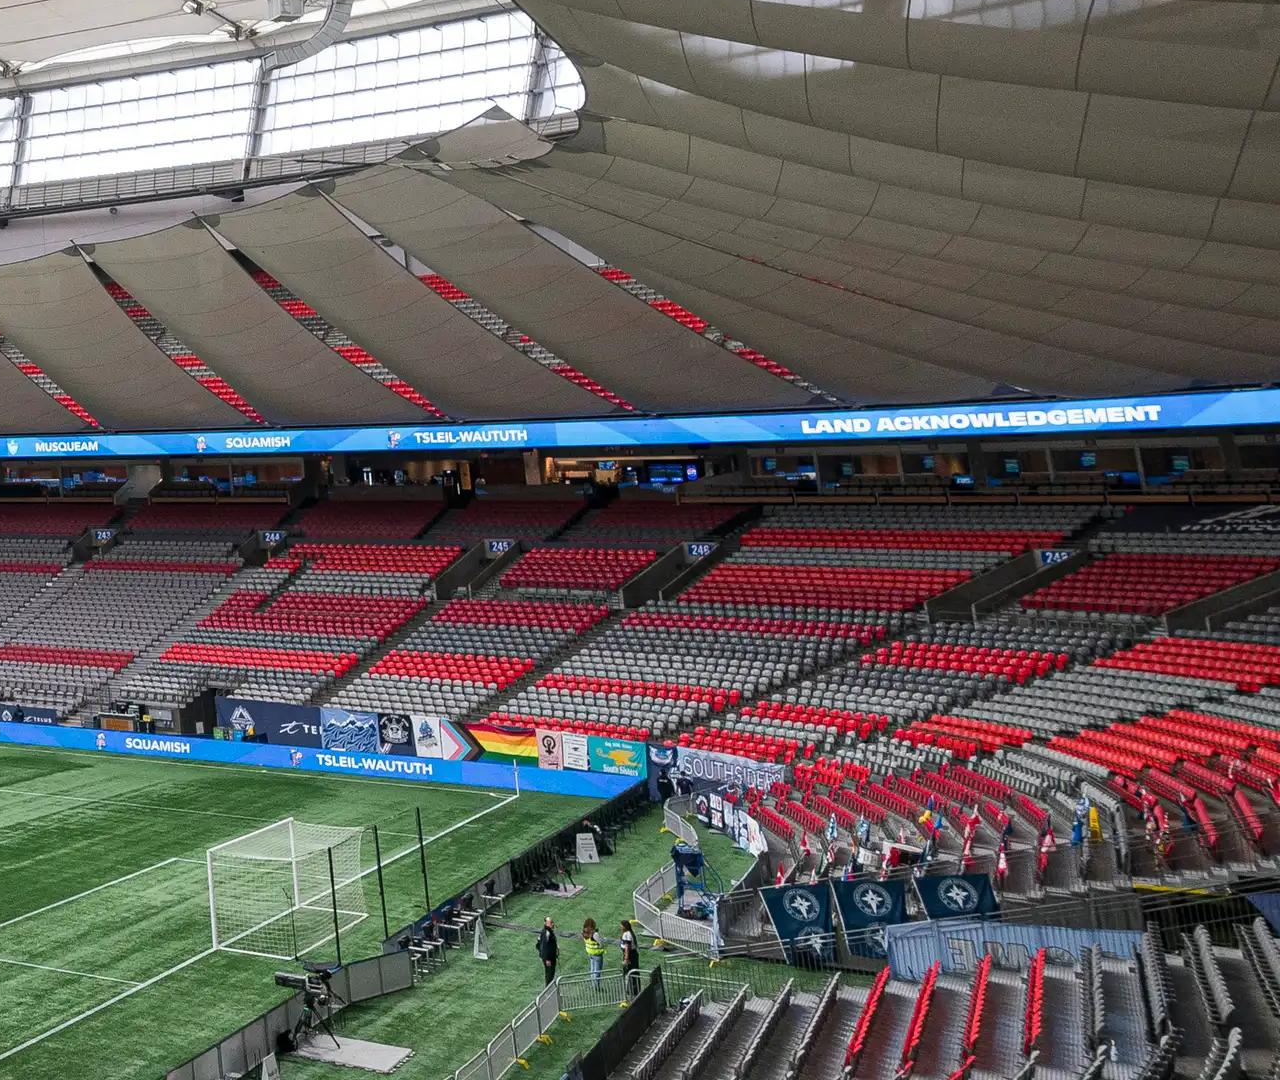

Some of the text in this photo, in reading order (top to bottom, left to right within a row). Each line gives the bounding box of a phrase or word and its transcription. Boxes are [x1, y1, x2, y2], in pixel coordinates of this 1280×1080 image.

[801, 405, 1161, 434] LAND ACKNOWLEDGEMENT
[225, 436, 291, 449] SQUAMISH
[414, 429, 527, 444] TSLEIL-WAUTUTH
[35, 440, 98, 453] MUSQUEAM
[96, 531, 111, 540] 243
[265, 532, 280, 542] 244
[492, 541, 509, 552] 245
[125, 737, 191, 754] SQUAMISH
[315, 754, 433, 776] TSLEIL-WAUTUTH
